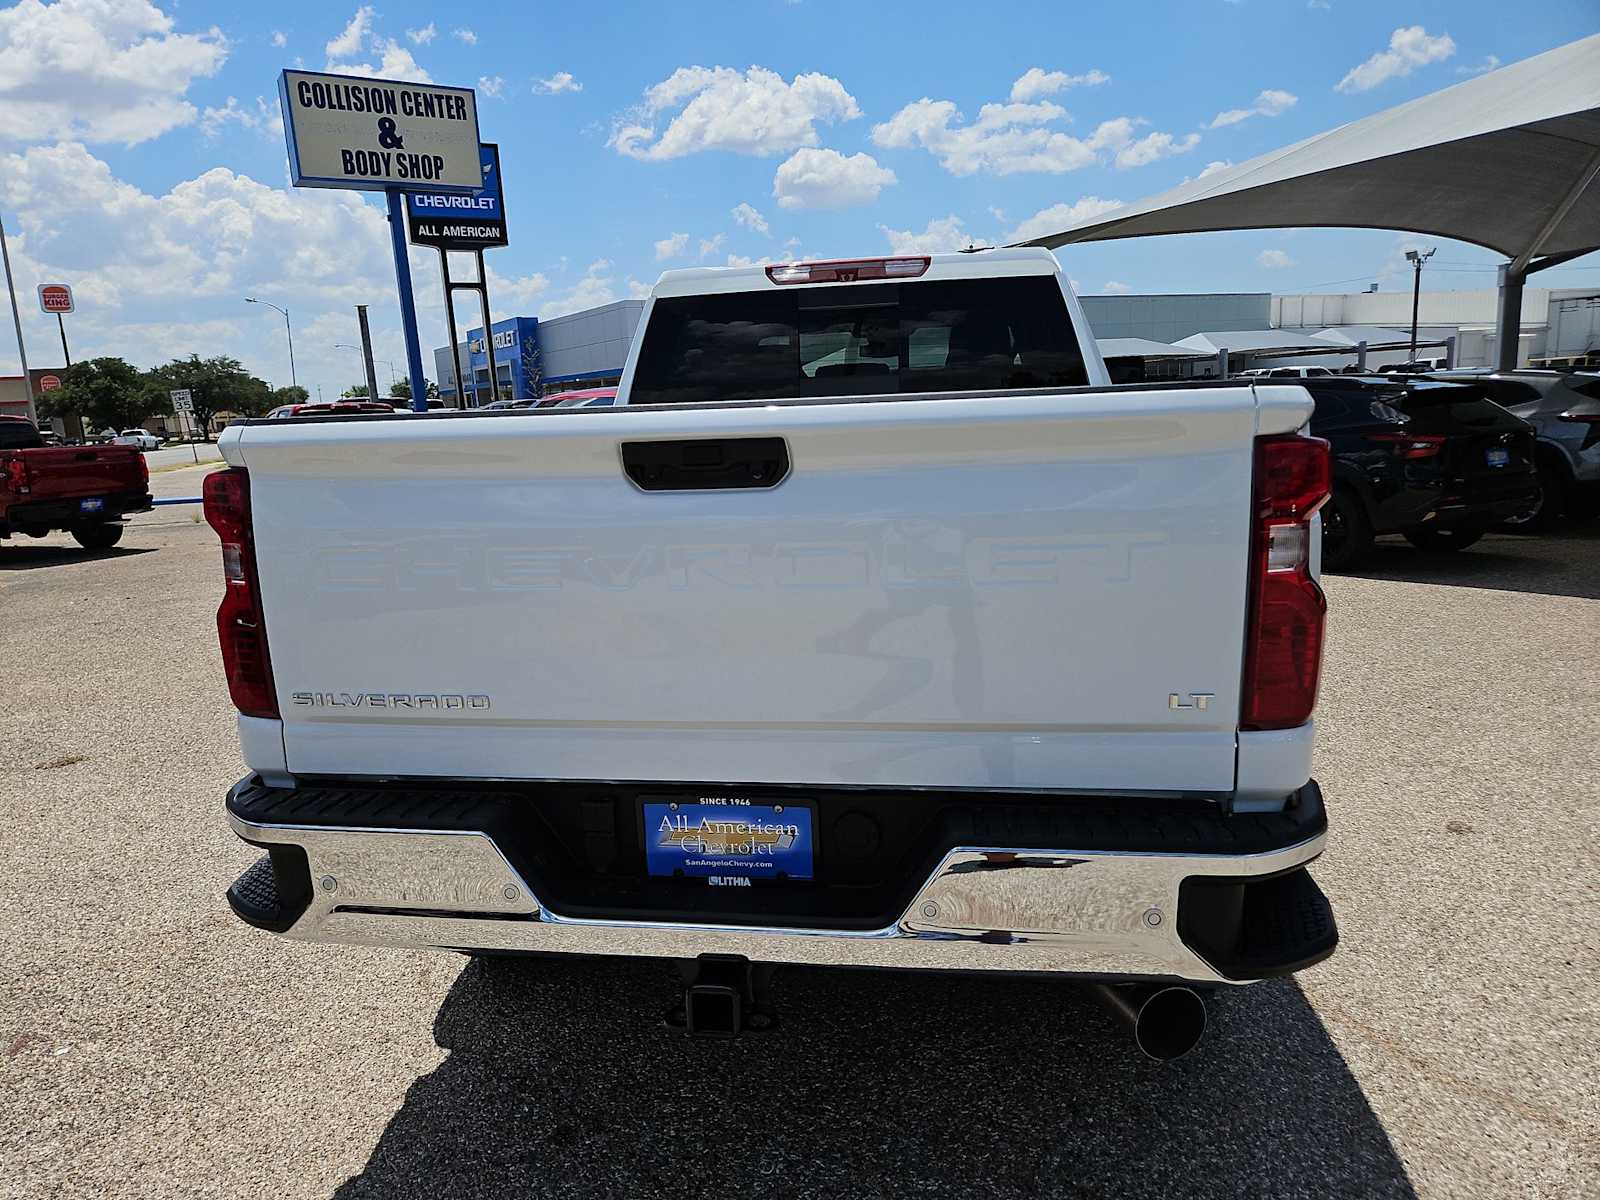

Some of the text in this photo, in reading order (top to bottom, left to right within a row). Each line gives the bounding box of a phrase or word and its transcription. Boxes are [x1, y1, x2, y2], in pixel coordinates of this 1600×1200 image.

[297, 80, 467, 121] COLLISION CENTER
[378, 117, 405, 149] &
[341, 149, 444, 180] BODY SHOP
[414, 194, 495, 210] CHEVROLET
[418, 224, 501, 238] ALL AMERICAN
[176, 401, 191, 410] 35
[292, 691, 491, 710] SILVERADO
[1168, 692, 1215, 710] LT
[699, 797, 727, 805] SINCE
[658, 815, 800, 836] All American
[681, 835, 775, 855] Chevrolet
[684, 859, 773, 868] SanAngeloChevy.com
